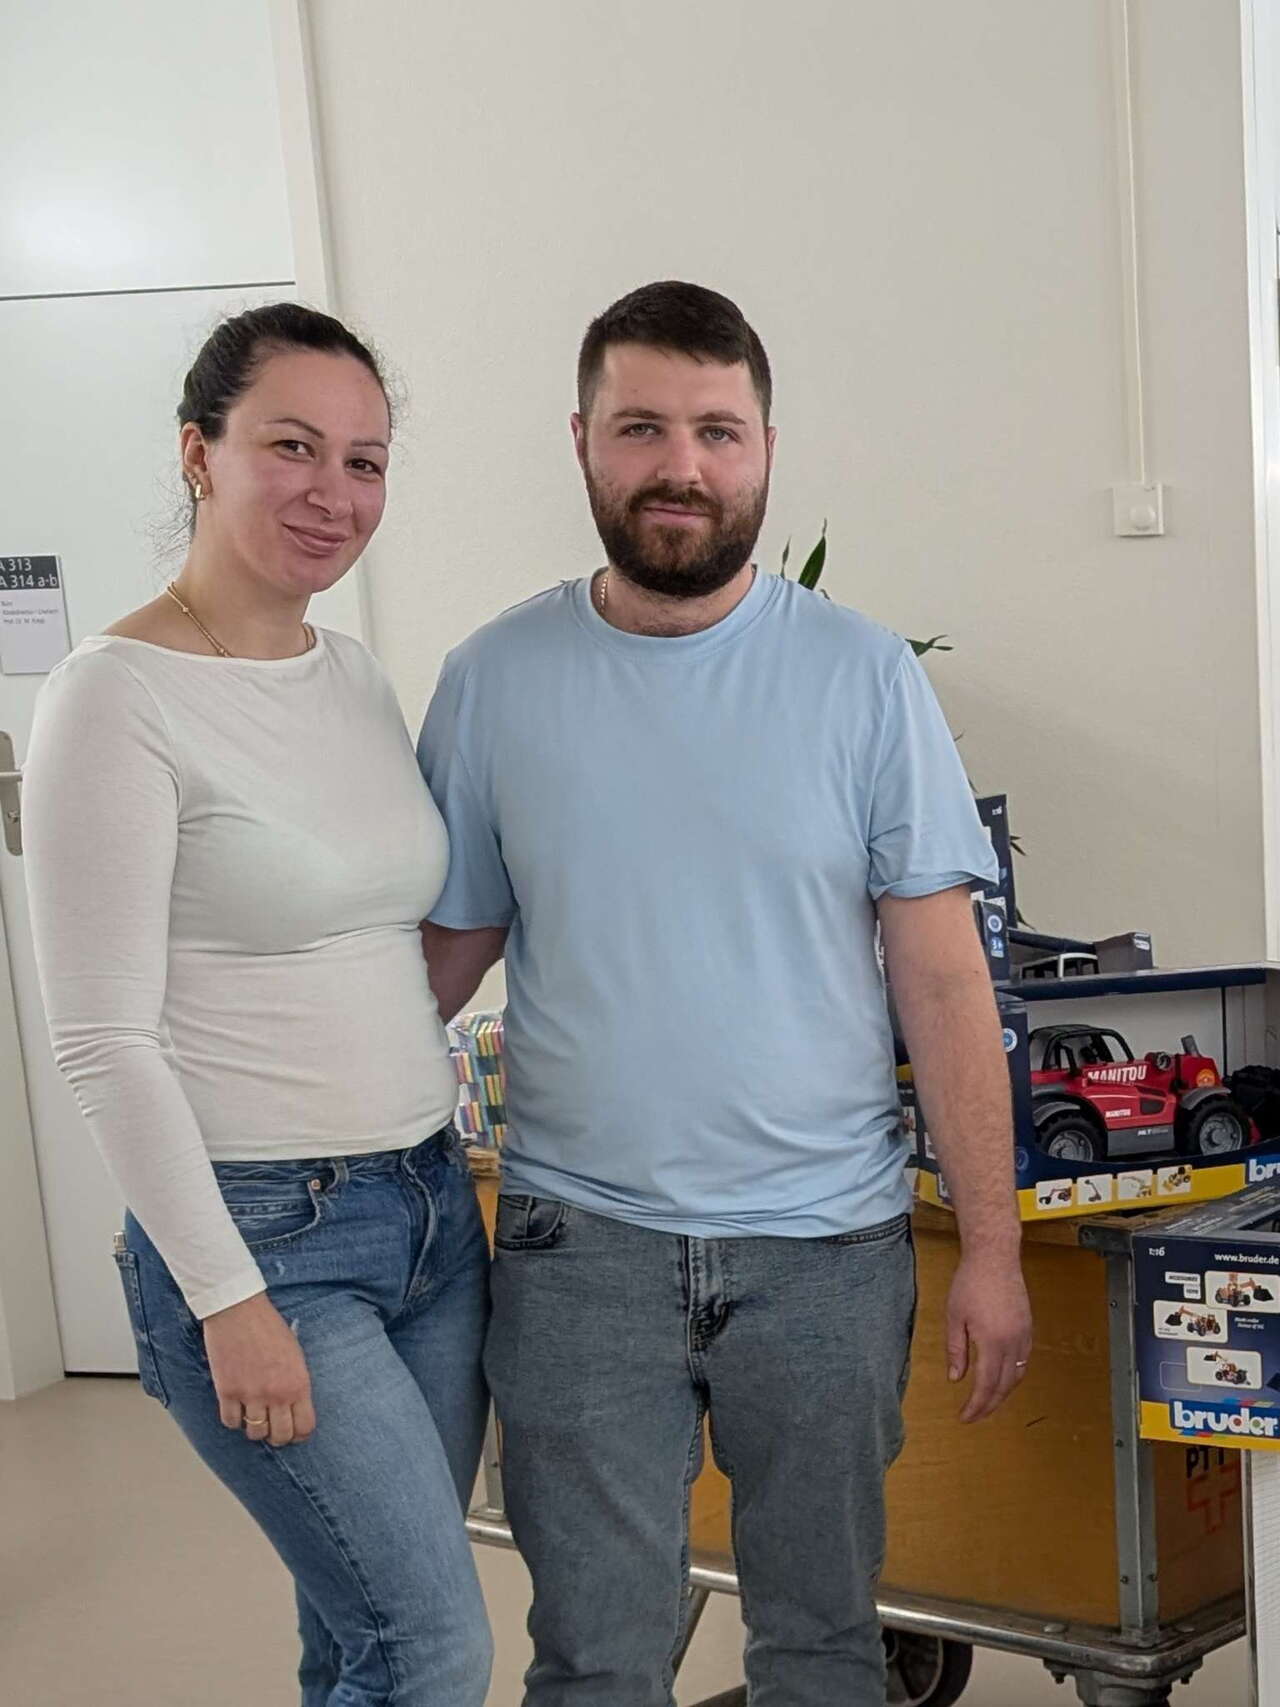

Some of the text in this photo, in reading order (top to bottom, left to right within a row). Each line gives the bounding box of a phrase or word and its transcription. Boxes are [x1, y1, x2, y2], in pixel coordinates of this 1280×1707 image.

[8, 558, 32, 572] 313
[11, 575, 34, 588] 314
[1087, 1065, 1147, 1081] MANITOU
[1214, 1252, 1280, 1265] www.bruder.de
[1173, 1401, 1278, 1437] bruder
